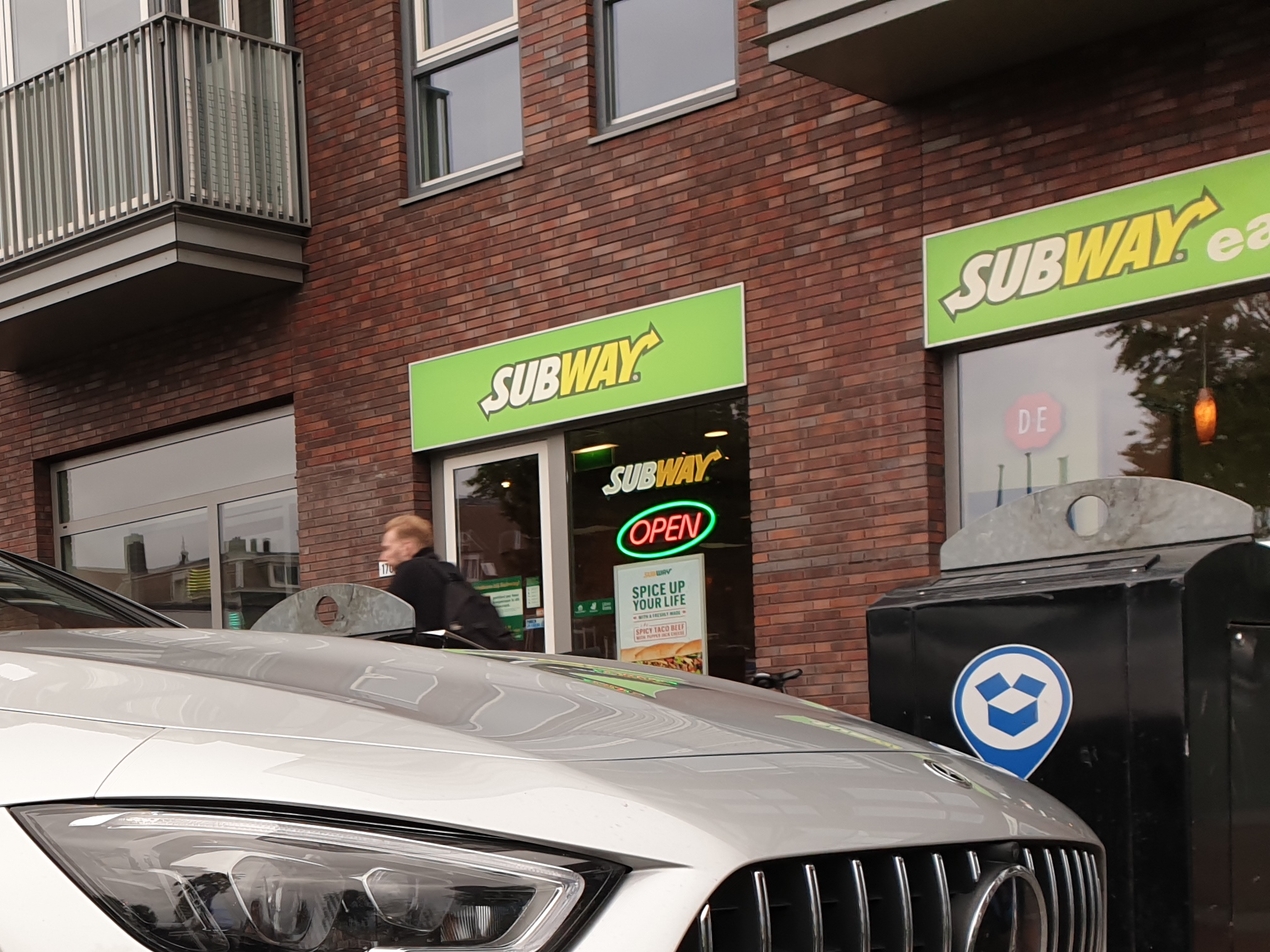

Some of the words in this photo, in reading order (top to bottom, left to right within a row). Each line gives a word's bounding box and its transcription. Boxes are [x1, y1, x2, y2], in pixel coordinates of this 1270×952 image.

[943, 189, 1221, 318] SUBWAY
[480, 325, 662, 417] SUBWAY
[602, 449, 722, 495] SUBWAY
[630, 512, 702, 545] OPEN
[632, 583, 666, 599] SPICE
[669, 580, 685, 594] UP
[632, 597, 662, 611] YOUR
[664, 594, 686, 607] LIFE
[636, 627, 653, 635] SPICY
[654, 625, 670, 633] TACO
[670, 623, 684, 631] BEEF
